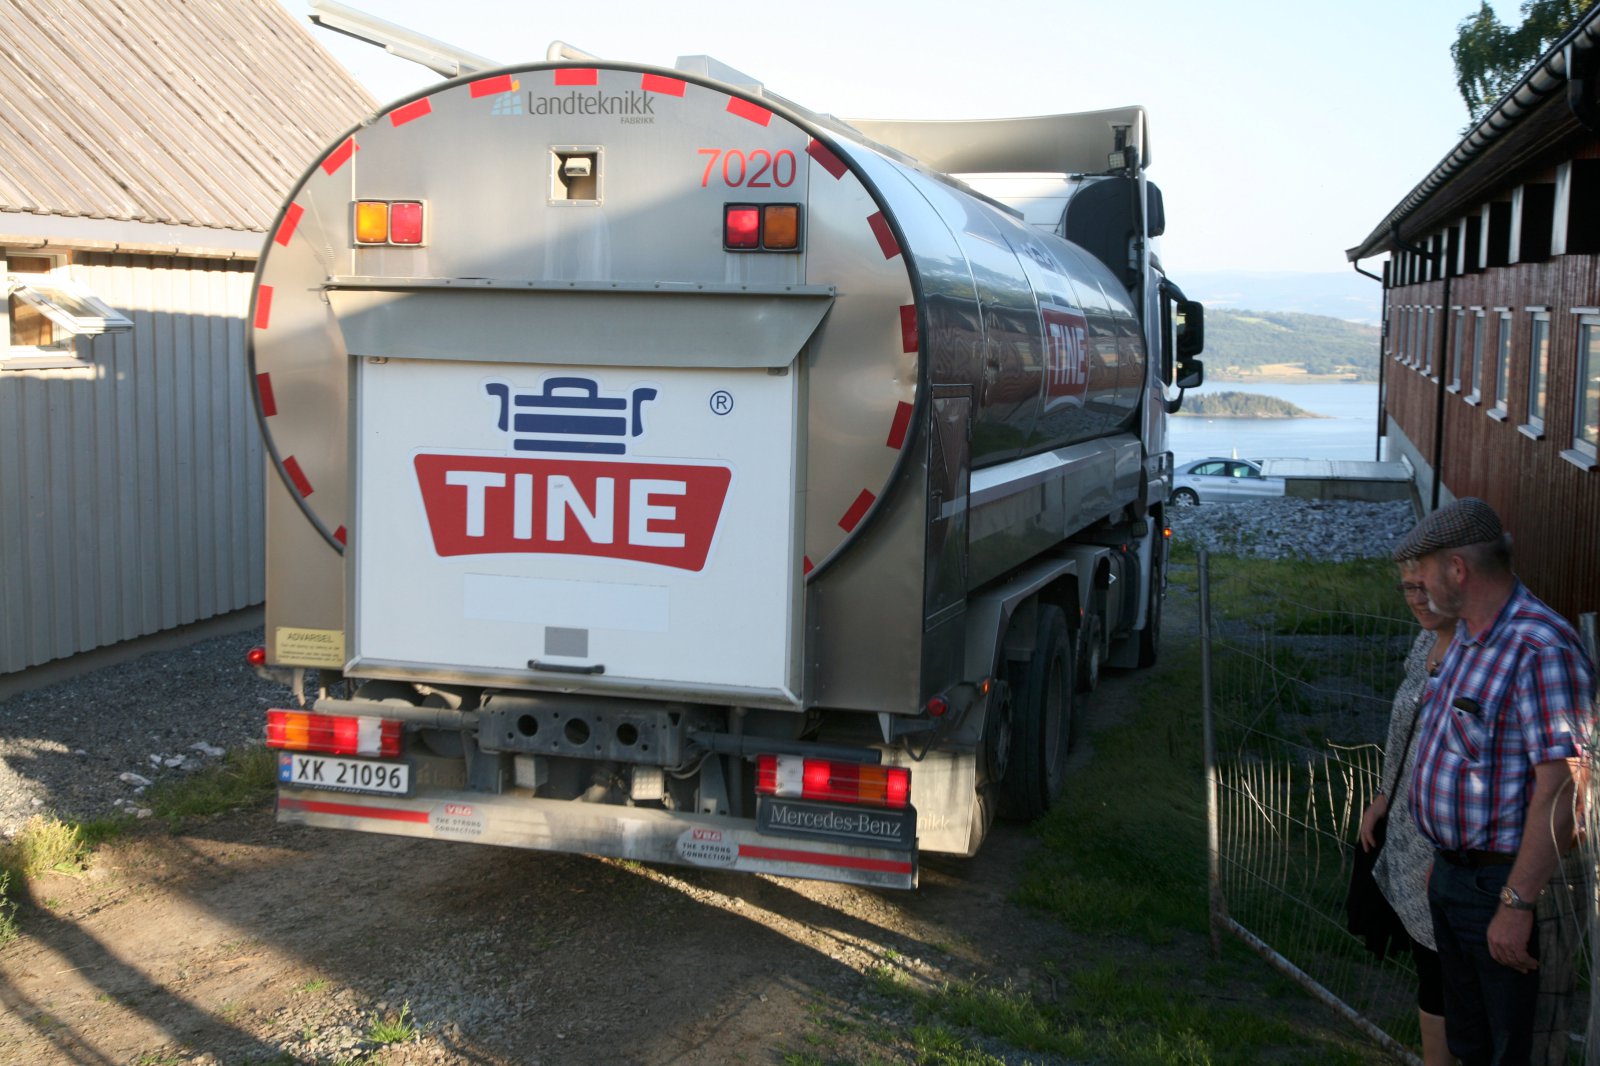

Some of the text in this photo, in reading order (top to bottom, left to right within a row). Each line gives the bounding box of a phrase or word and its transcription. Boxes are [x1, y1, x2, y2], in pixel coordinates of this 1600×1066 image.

[528, 90, 655, 115] landteknikk
[620, 116, 655, 125] FABRIKK
[697, 148, 797, 188] 7020
[1049, 322, 1086, 385] TINE
[445, 470, 687, 548] TINE
[298, 759, 401, 789] XK 21096
[770, 804, 902, 838] Mercedes-Benz
[682, 842, 731, 853] THE STRONG
[693, 830, 721, 841] VBG
[681, 850, 731, 861] CONNECTION
